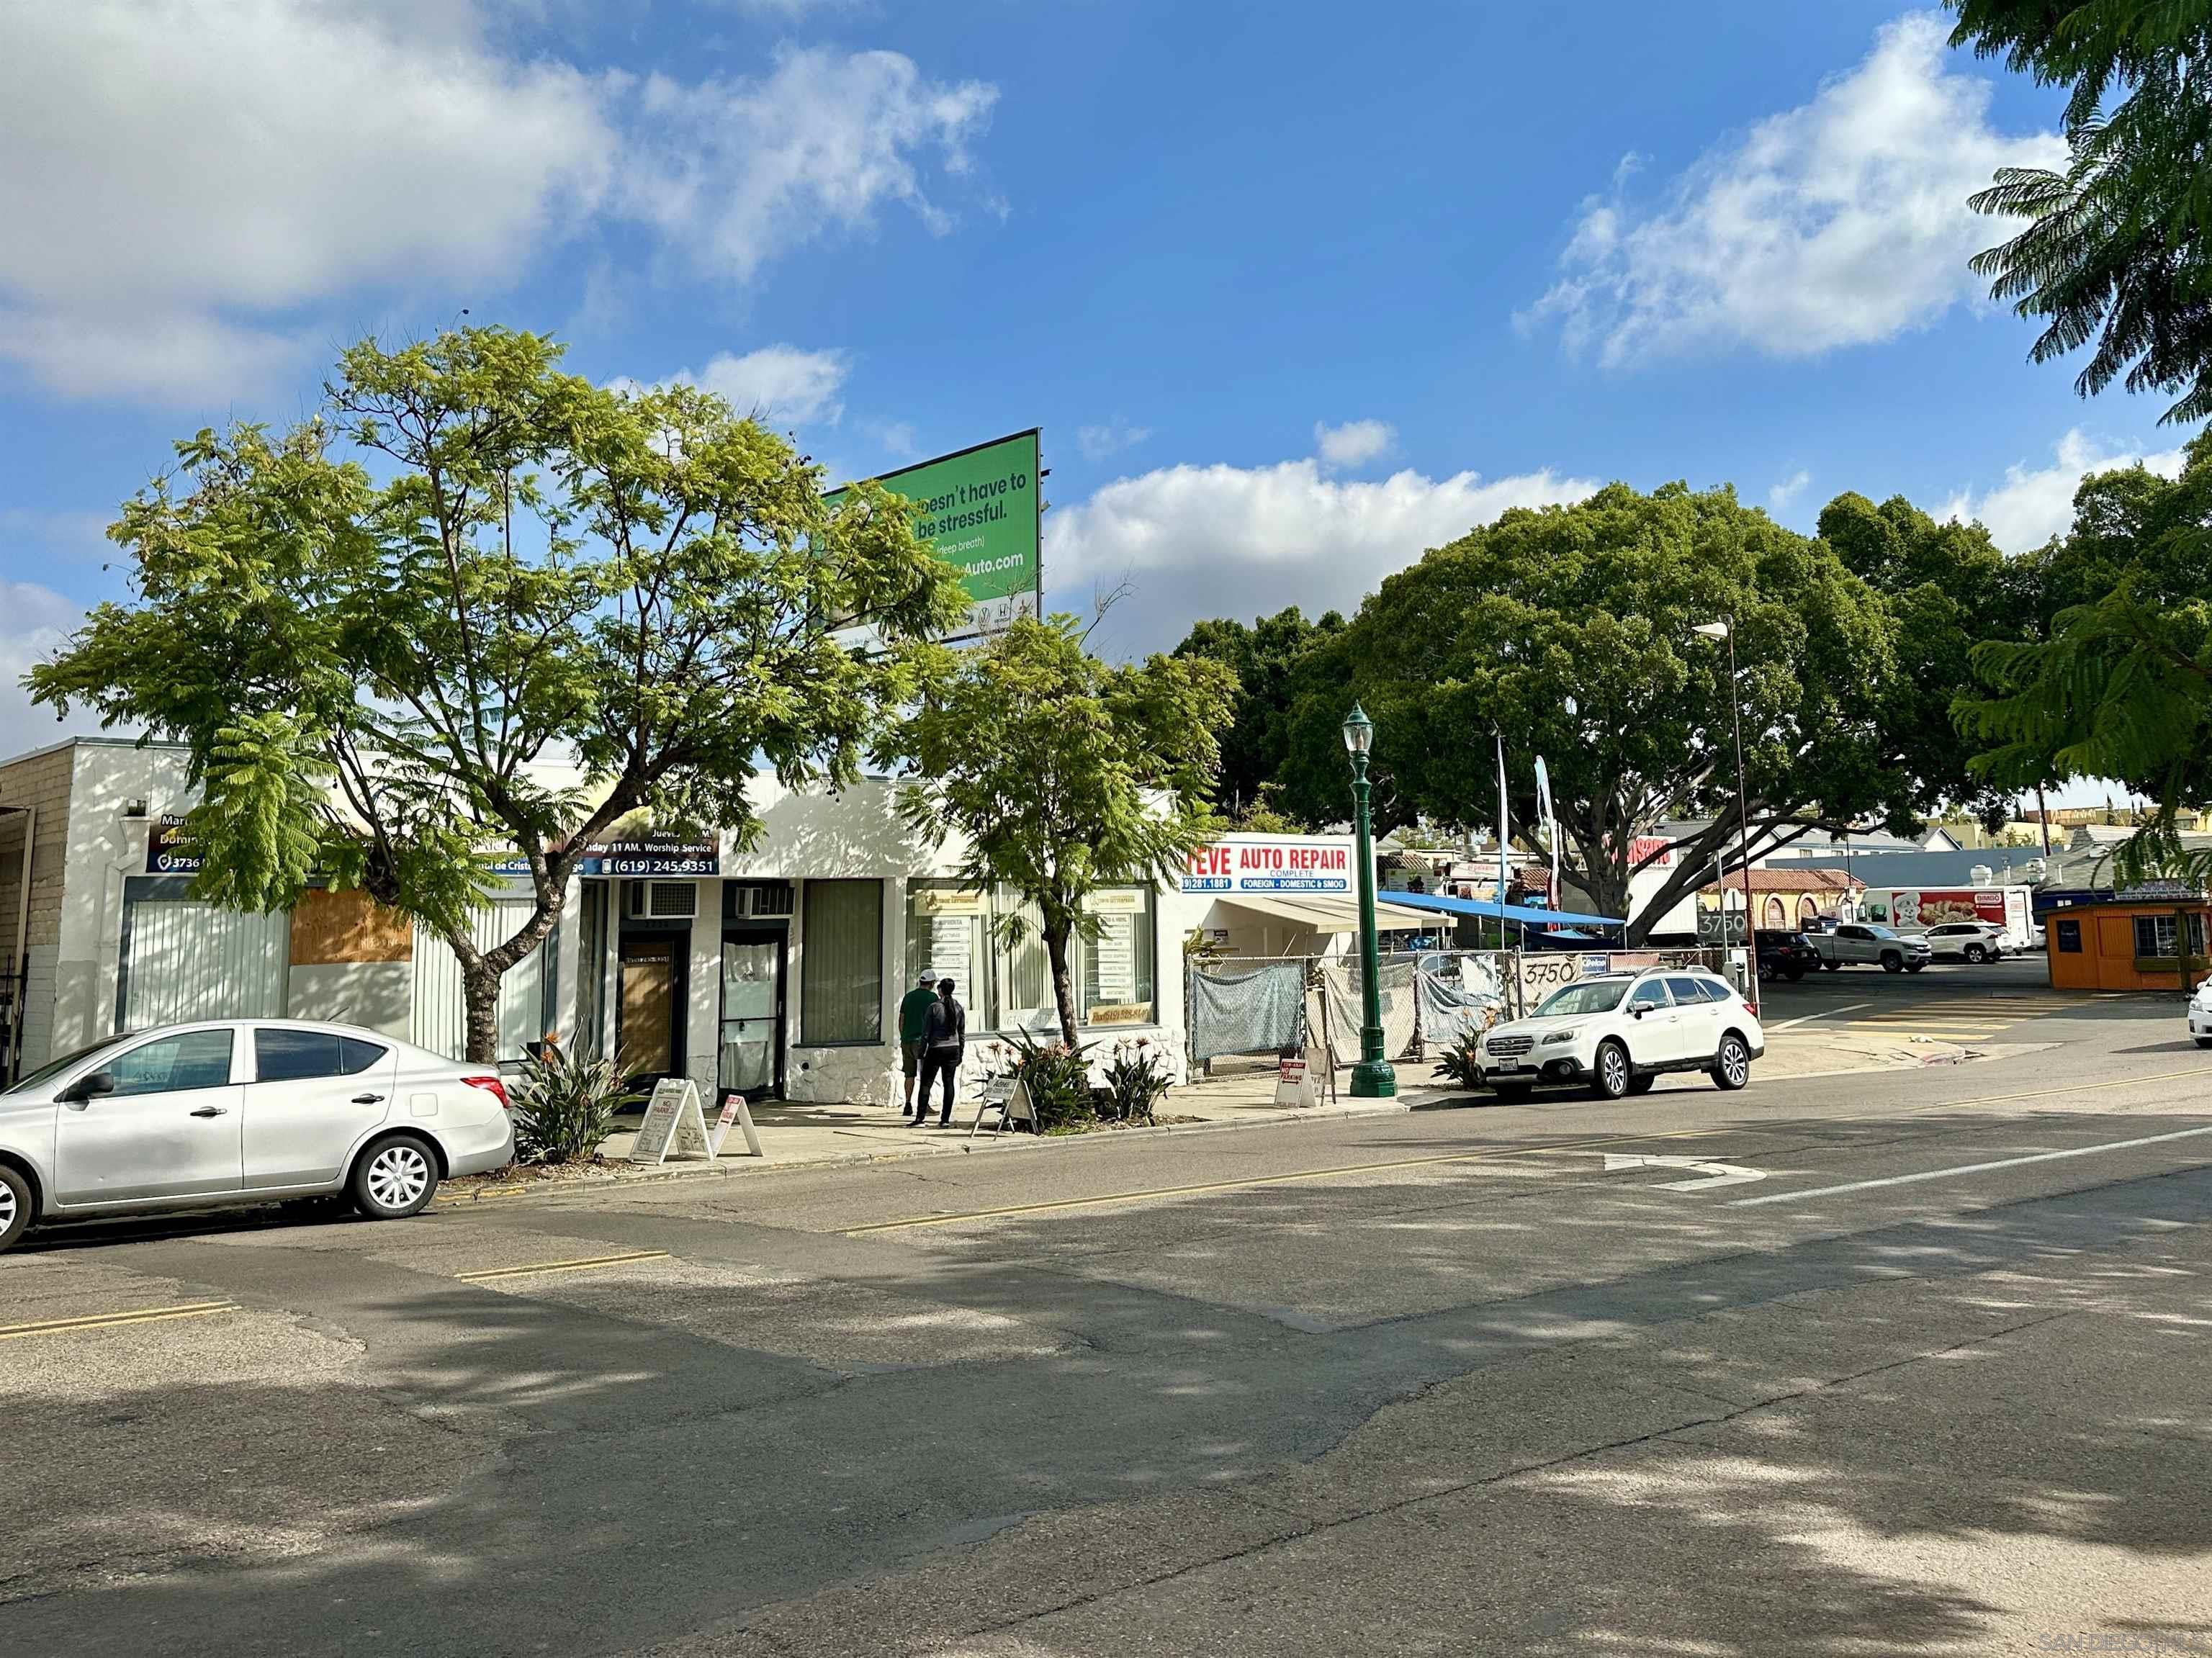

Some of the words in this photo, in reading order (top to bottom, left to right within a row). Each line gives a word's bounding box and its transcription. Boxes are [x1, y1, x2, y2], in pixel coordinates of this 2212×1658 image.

[968, 478, 1007, 503] have
[1010, 472, 1026, 490] to
[918, 521, 936, 539] be
[938, 500, 1007, 534] stressful.
[958, 535, 985, 551] breath)
[585, 842, 608, 853] nday
[612, 843, 622, 852] 11
[624, 843, 641, 852] AM.
[644, 843, 679, 854] Worship
[682, 843, 711, 852] Service
[172, 857, 200, 868] 3736
[508, 861, 531, 870] Crist
[615, 860, 649, 873] (619)
[653, 861, 713, 872] 245.9351
[1187, 847, 1231, 875] EVE
[1239, 848, 1282, 870] AUTO
[1290, 849, 1346, 870] REPAIR
[1281, 880, 1315, 888] DOMESTIC
[1699, 915, 1746, 933] 3750
[1524, 962, 1575, 984] 3750
